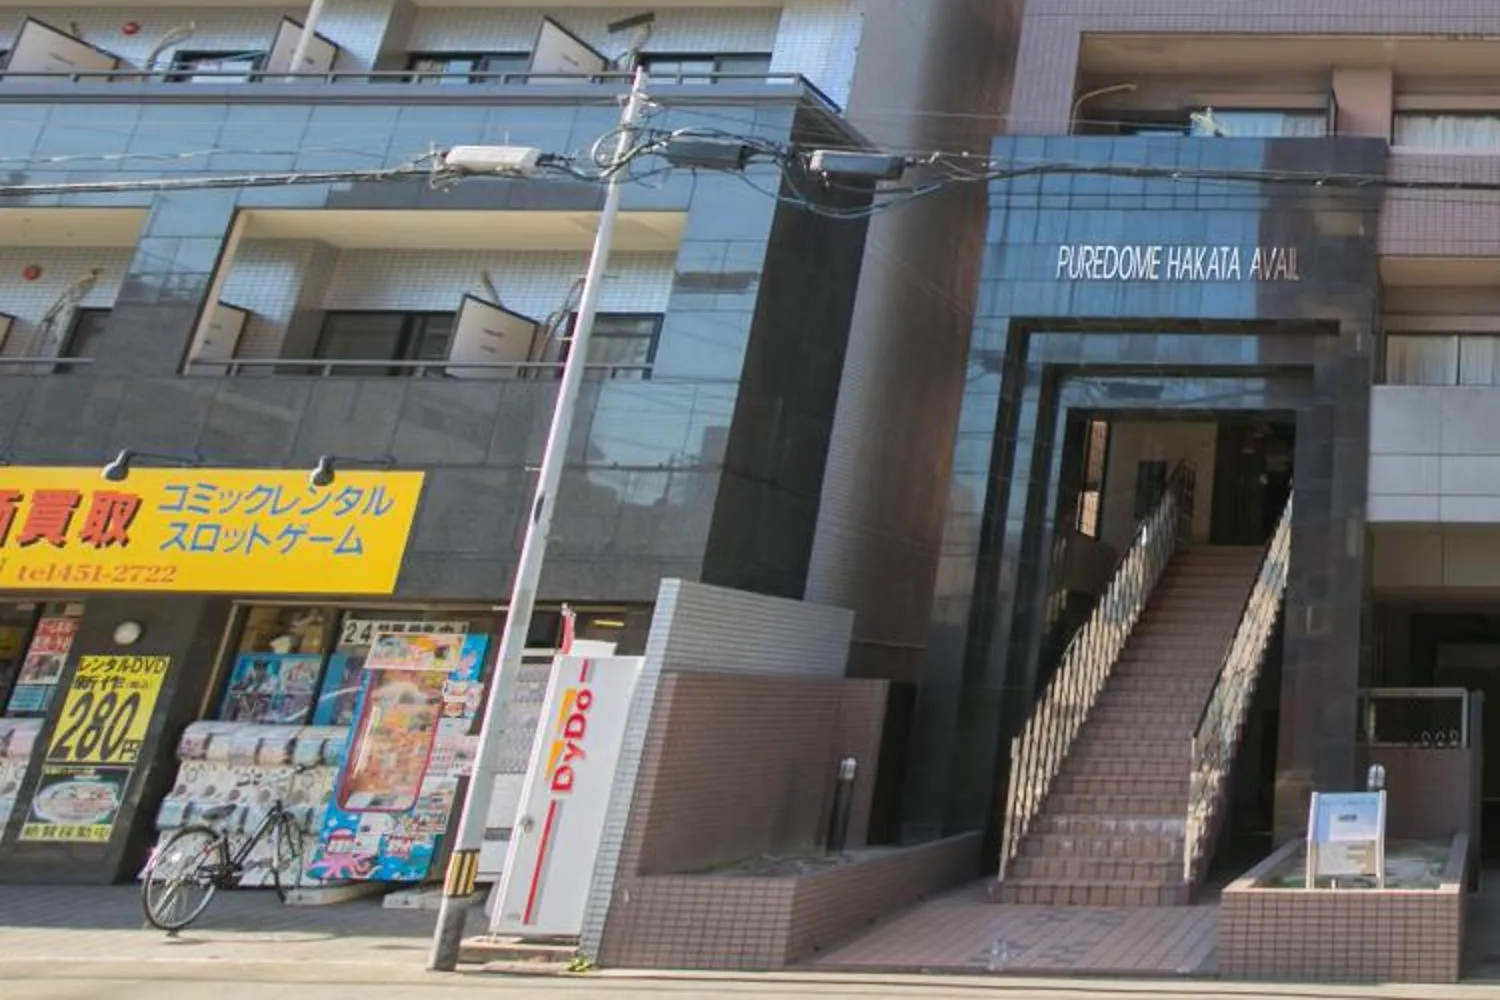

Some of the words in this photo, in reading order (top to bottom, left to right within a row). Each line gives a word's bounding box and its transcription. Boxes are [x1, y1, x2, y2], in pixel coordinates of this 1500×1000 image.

[1055, 245, 1162, 280] PUREDOME
[1166, 246, 1241, 281] HAKATA
[157, 482, 395, 517] コミックレンタル
[159, 523, 364, 555] スロットゲーム
[551, 686, 593, 793] DyDo
